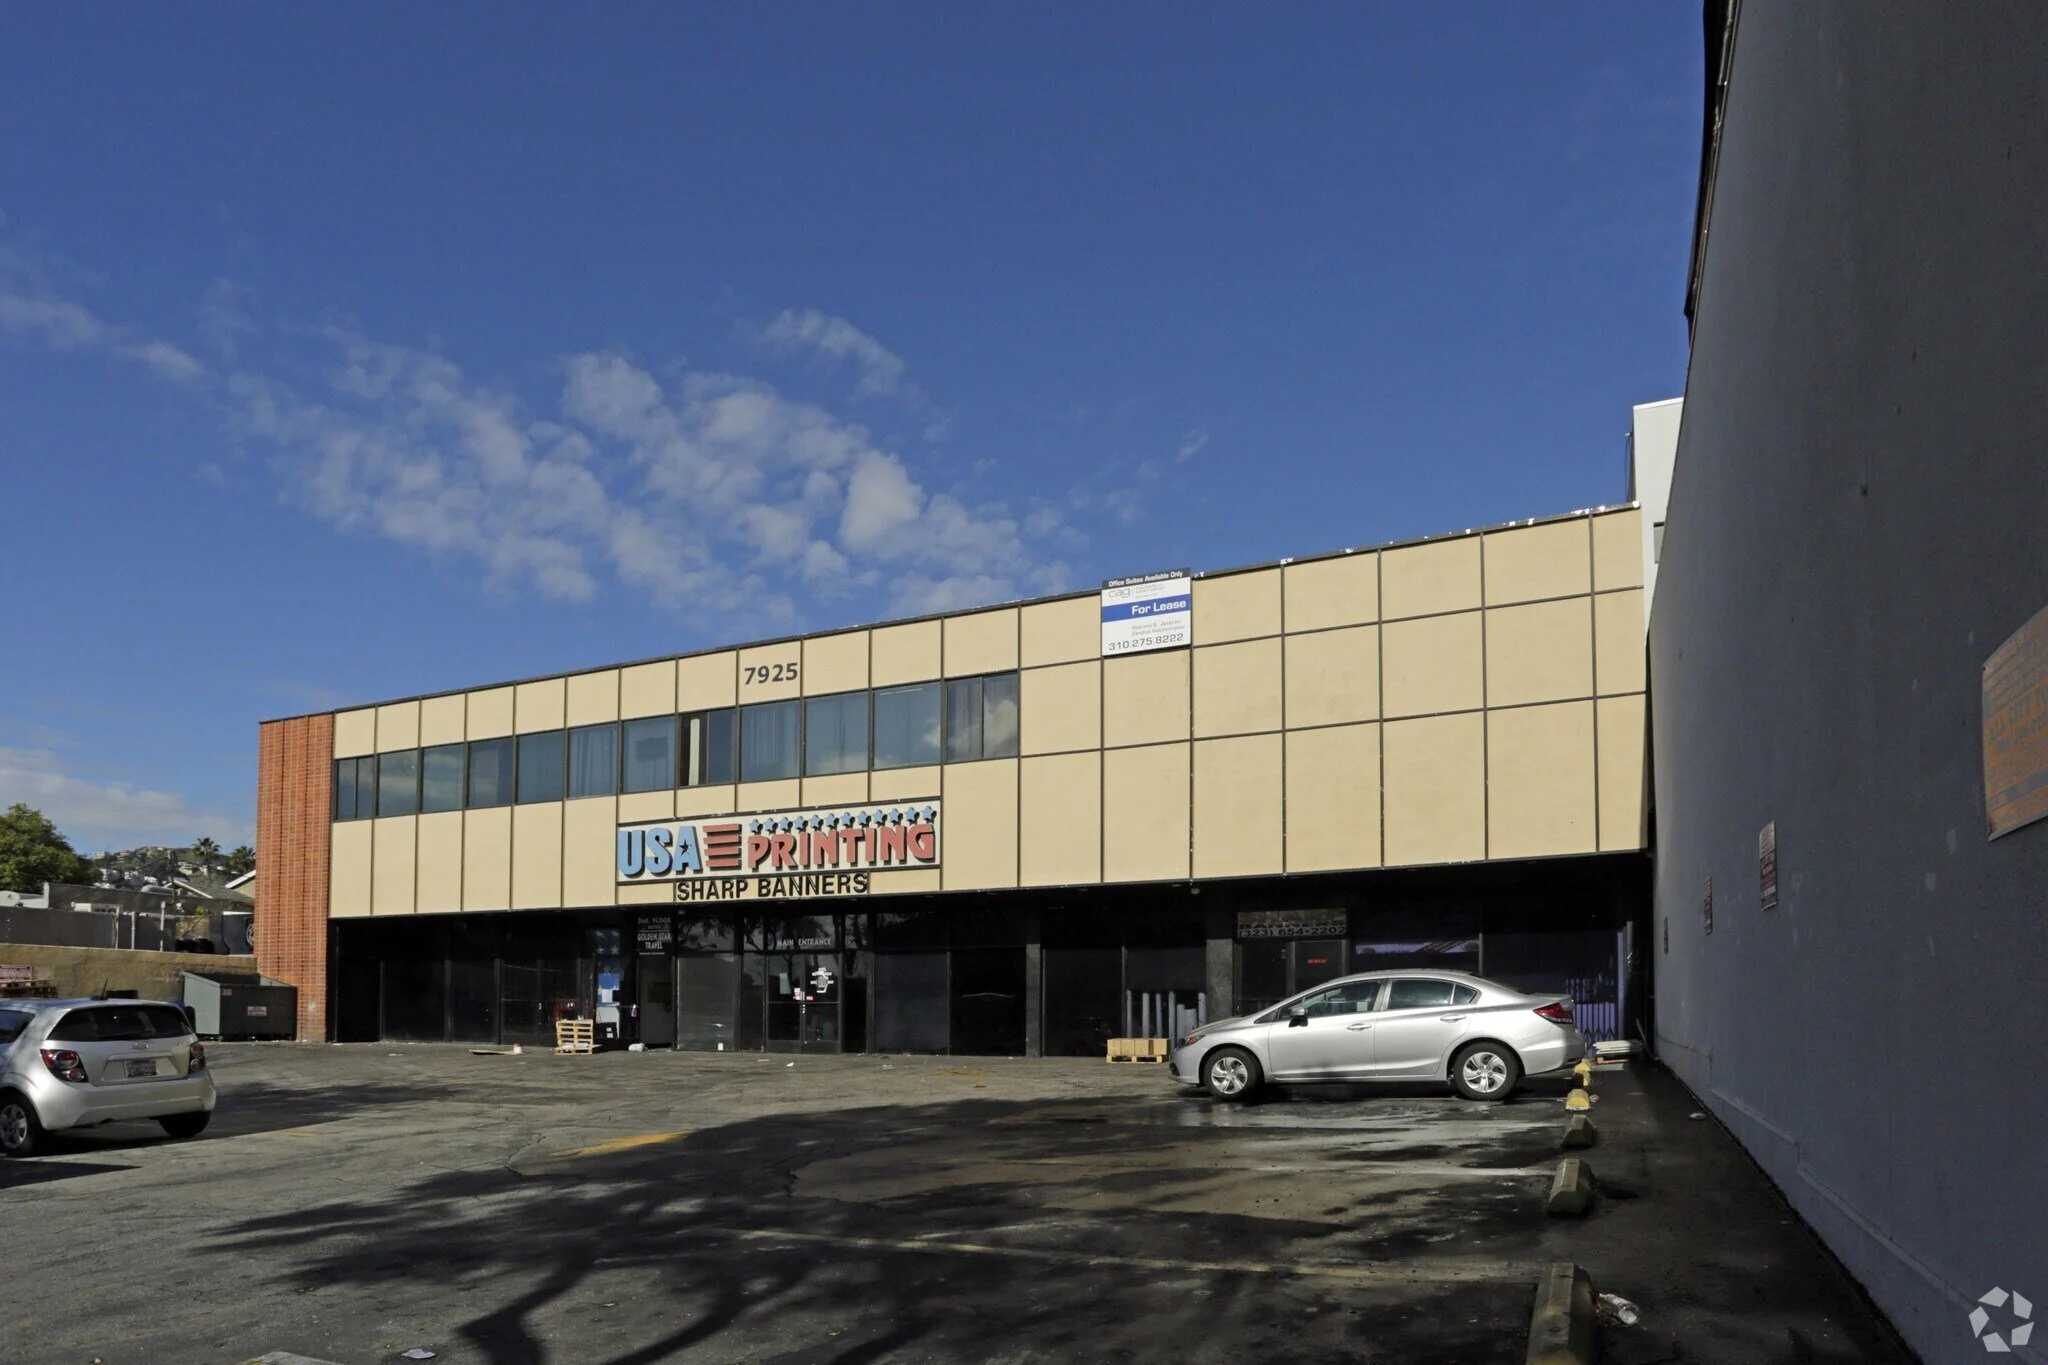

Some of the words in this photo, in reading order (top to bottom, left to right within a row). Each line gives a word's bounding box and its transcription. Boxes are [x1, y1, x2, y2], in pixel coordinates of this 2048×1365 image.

[1108, 579, 1125, 588] Office
[1125, 576, 1143, 584] Suites
[1144, 573, 1169, 582] Available
[1131, 605, 1151, 615] For
[1153, 600, 1187, 612] Lease
[1108, 633, 1184, 651] 310.275.8222
[744, 662, 798, 685] 7925
[617, 824, 701, 877] USA
[747, 822, 936, 872] PRINTING
[676, 878, 748, 900] SHARP
[757, 873, 869, 898] BANNERS
[637, 932, 657, 941] GOLDEN
[658, 932, 672, 940] STAR
[1239, 928, 1274, 937] (323)
[645, 941, 663, 950] TRAVEL
[776, 939, 794, 947] MAIN
[798, 937, 832, 946] ENTRANCE
